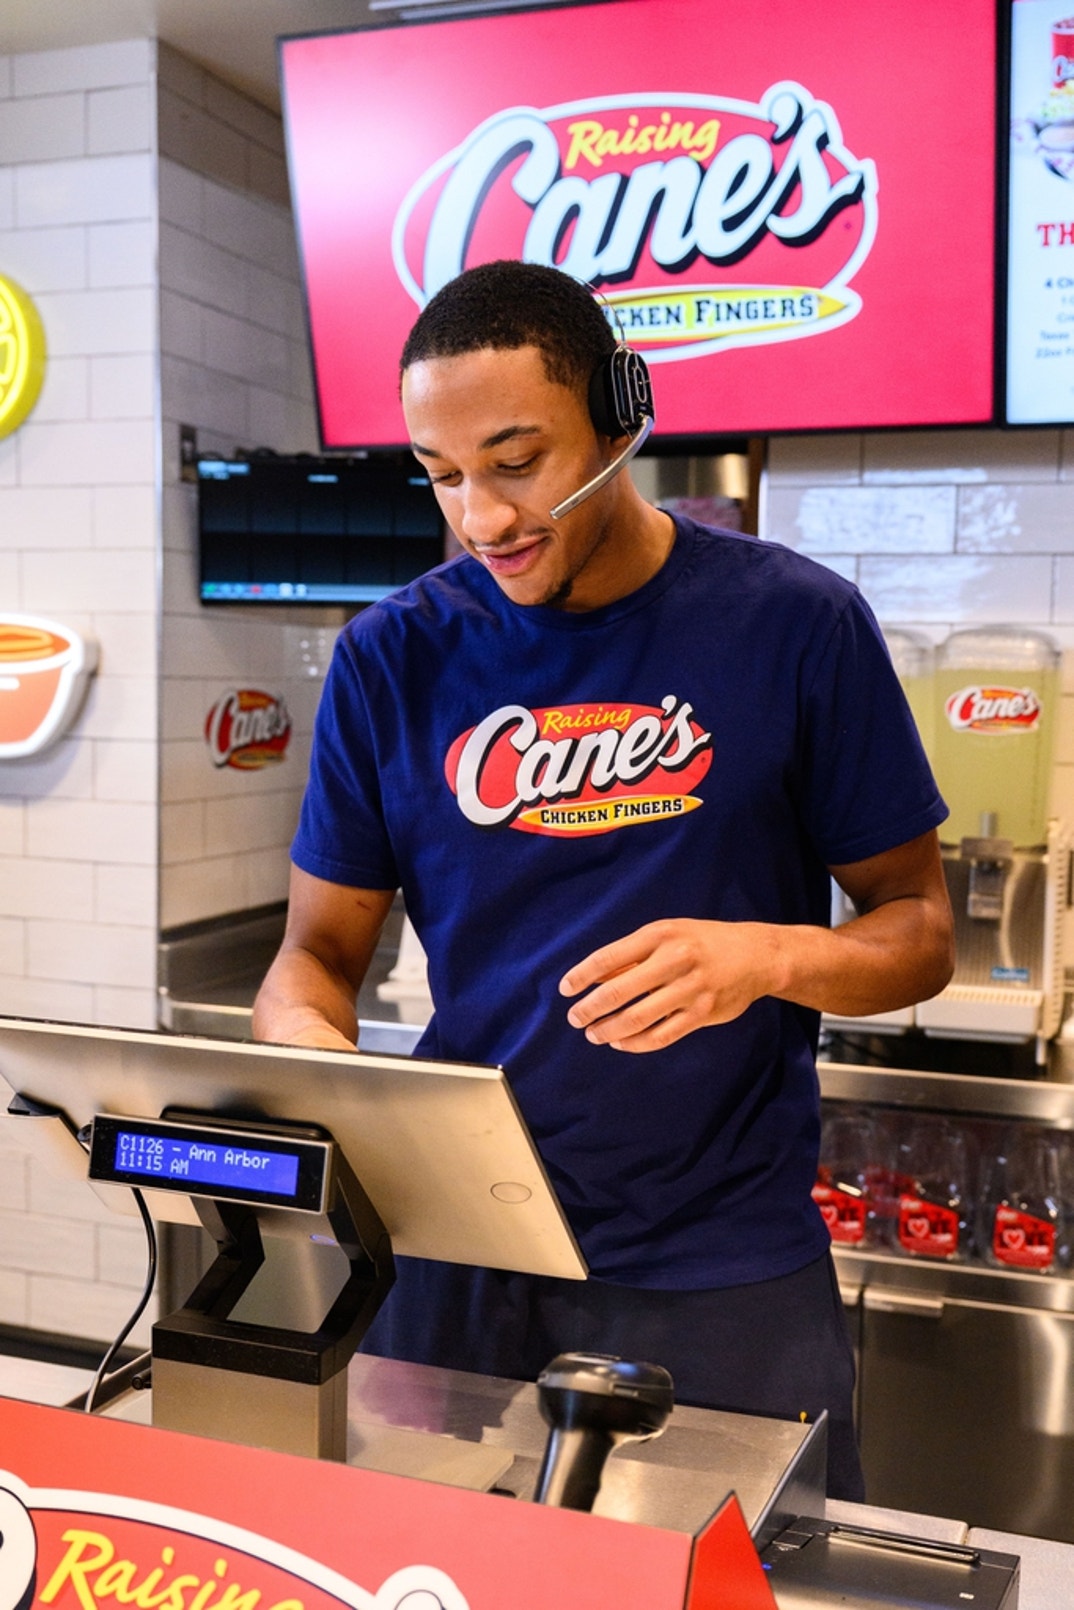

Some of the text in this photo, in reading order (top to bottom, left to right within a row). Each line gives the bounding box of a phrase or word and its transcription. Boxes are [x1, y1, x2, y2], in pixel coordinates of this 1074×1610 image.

[565, 112, 721, 169] Raising
[422, 91, 865, 300] Cane's
[695, 293, 815, 323] FINGERS
[542, 708, 632, 735] Raising
[456, 694, 712, 826] Cane's
[541, 798, 682, 825] CHICKEN FINGERS
[119, 1134, 165, 1155] C1126
[189, 1144, 217, 1163] Ann
[224, 1151, 271, 1170] Arbor
[120, 1152, 190, 1176] 11:15 AM
[39, 1529, 304, 1610] Raisin
